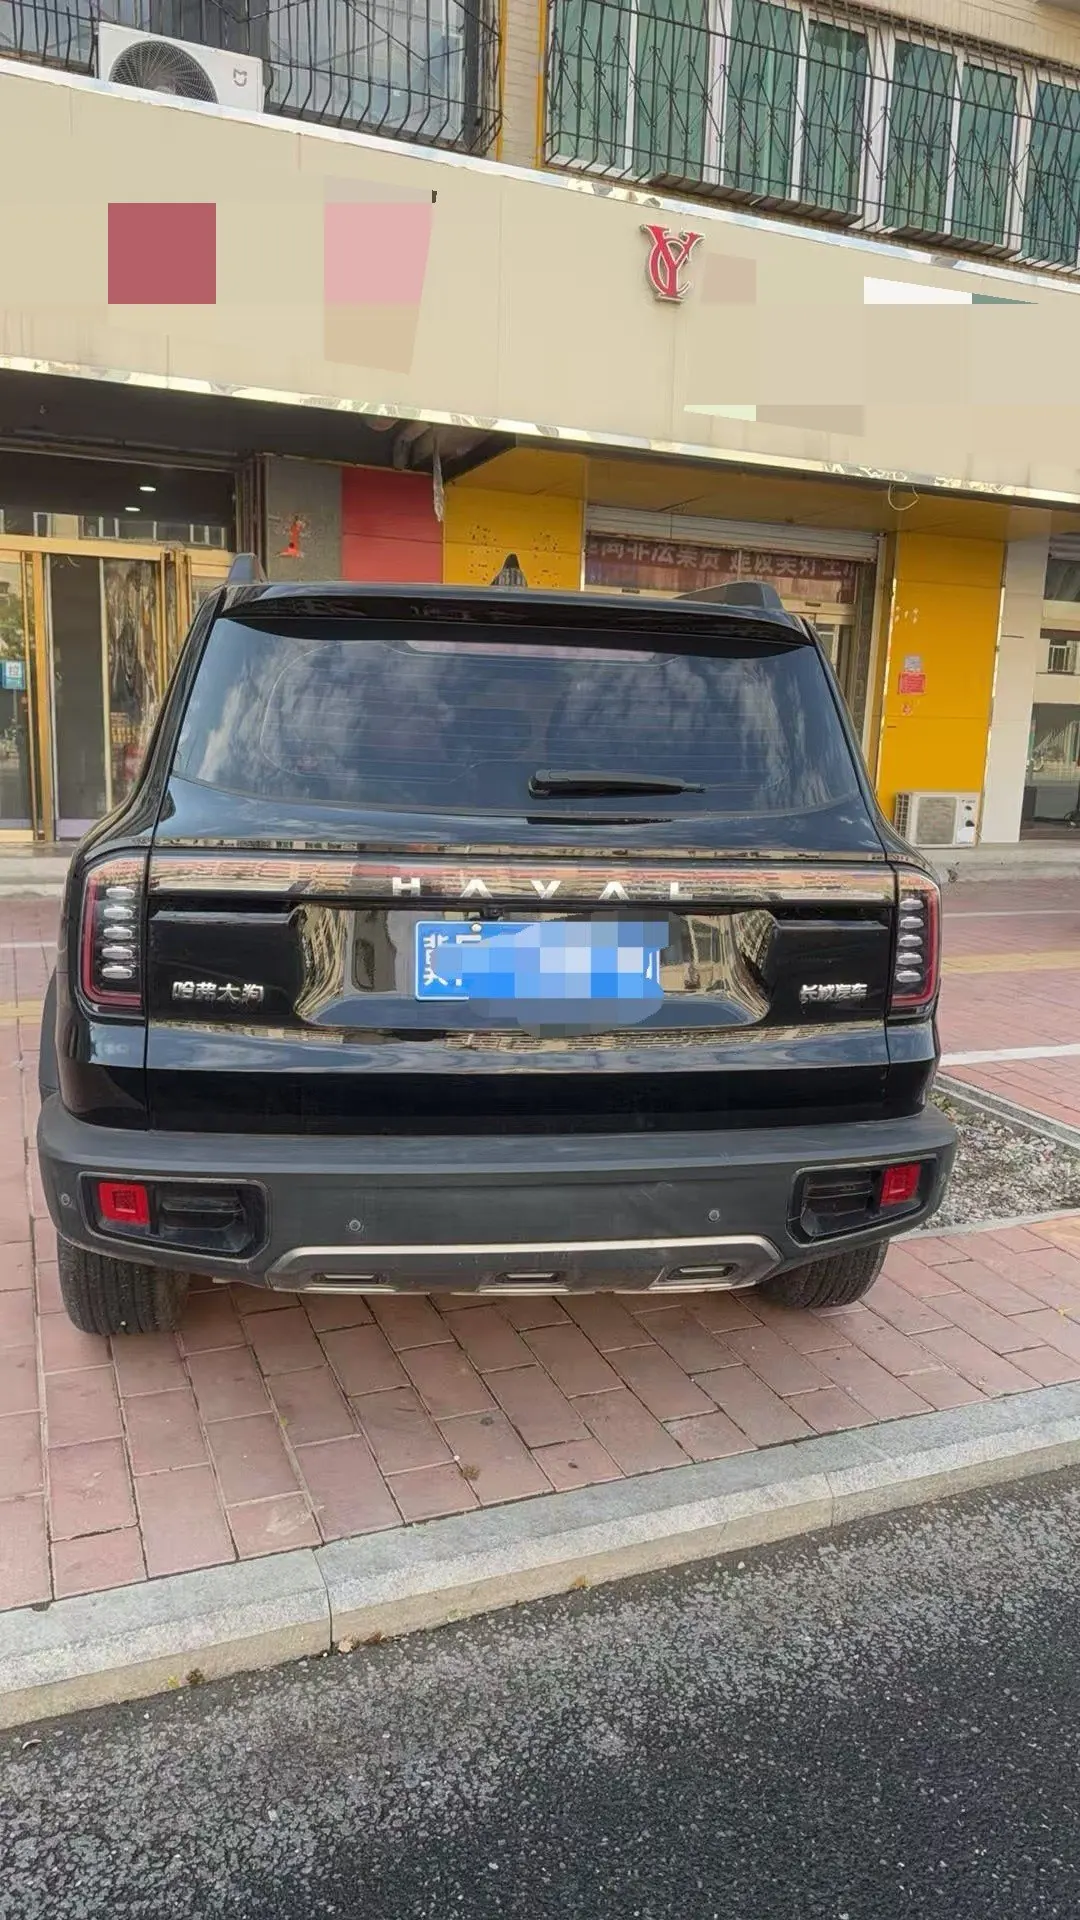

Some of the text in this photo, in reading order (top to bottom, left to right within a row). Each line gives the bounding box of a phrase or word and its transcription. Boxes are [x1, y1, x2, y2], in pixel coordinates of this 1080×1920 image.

[392, 877, 693, 900] HAVAL
[172, 981, 264, 1003] 哈弗大狗
[800, 983, 868, 1002] 长城汽车
